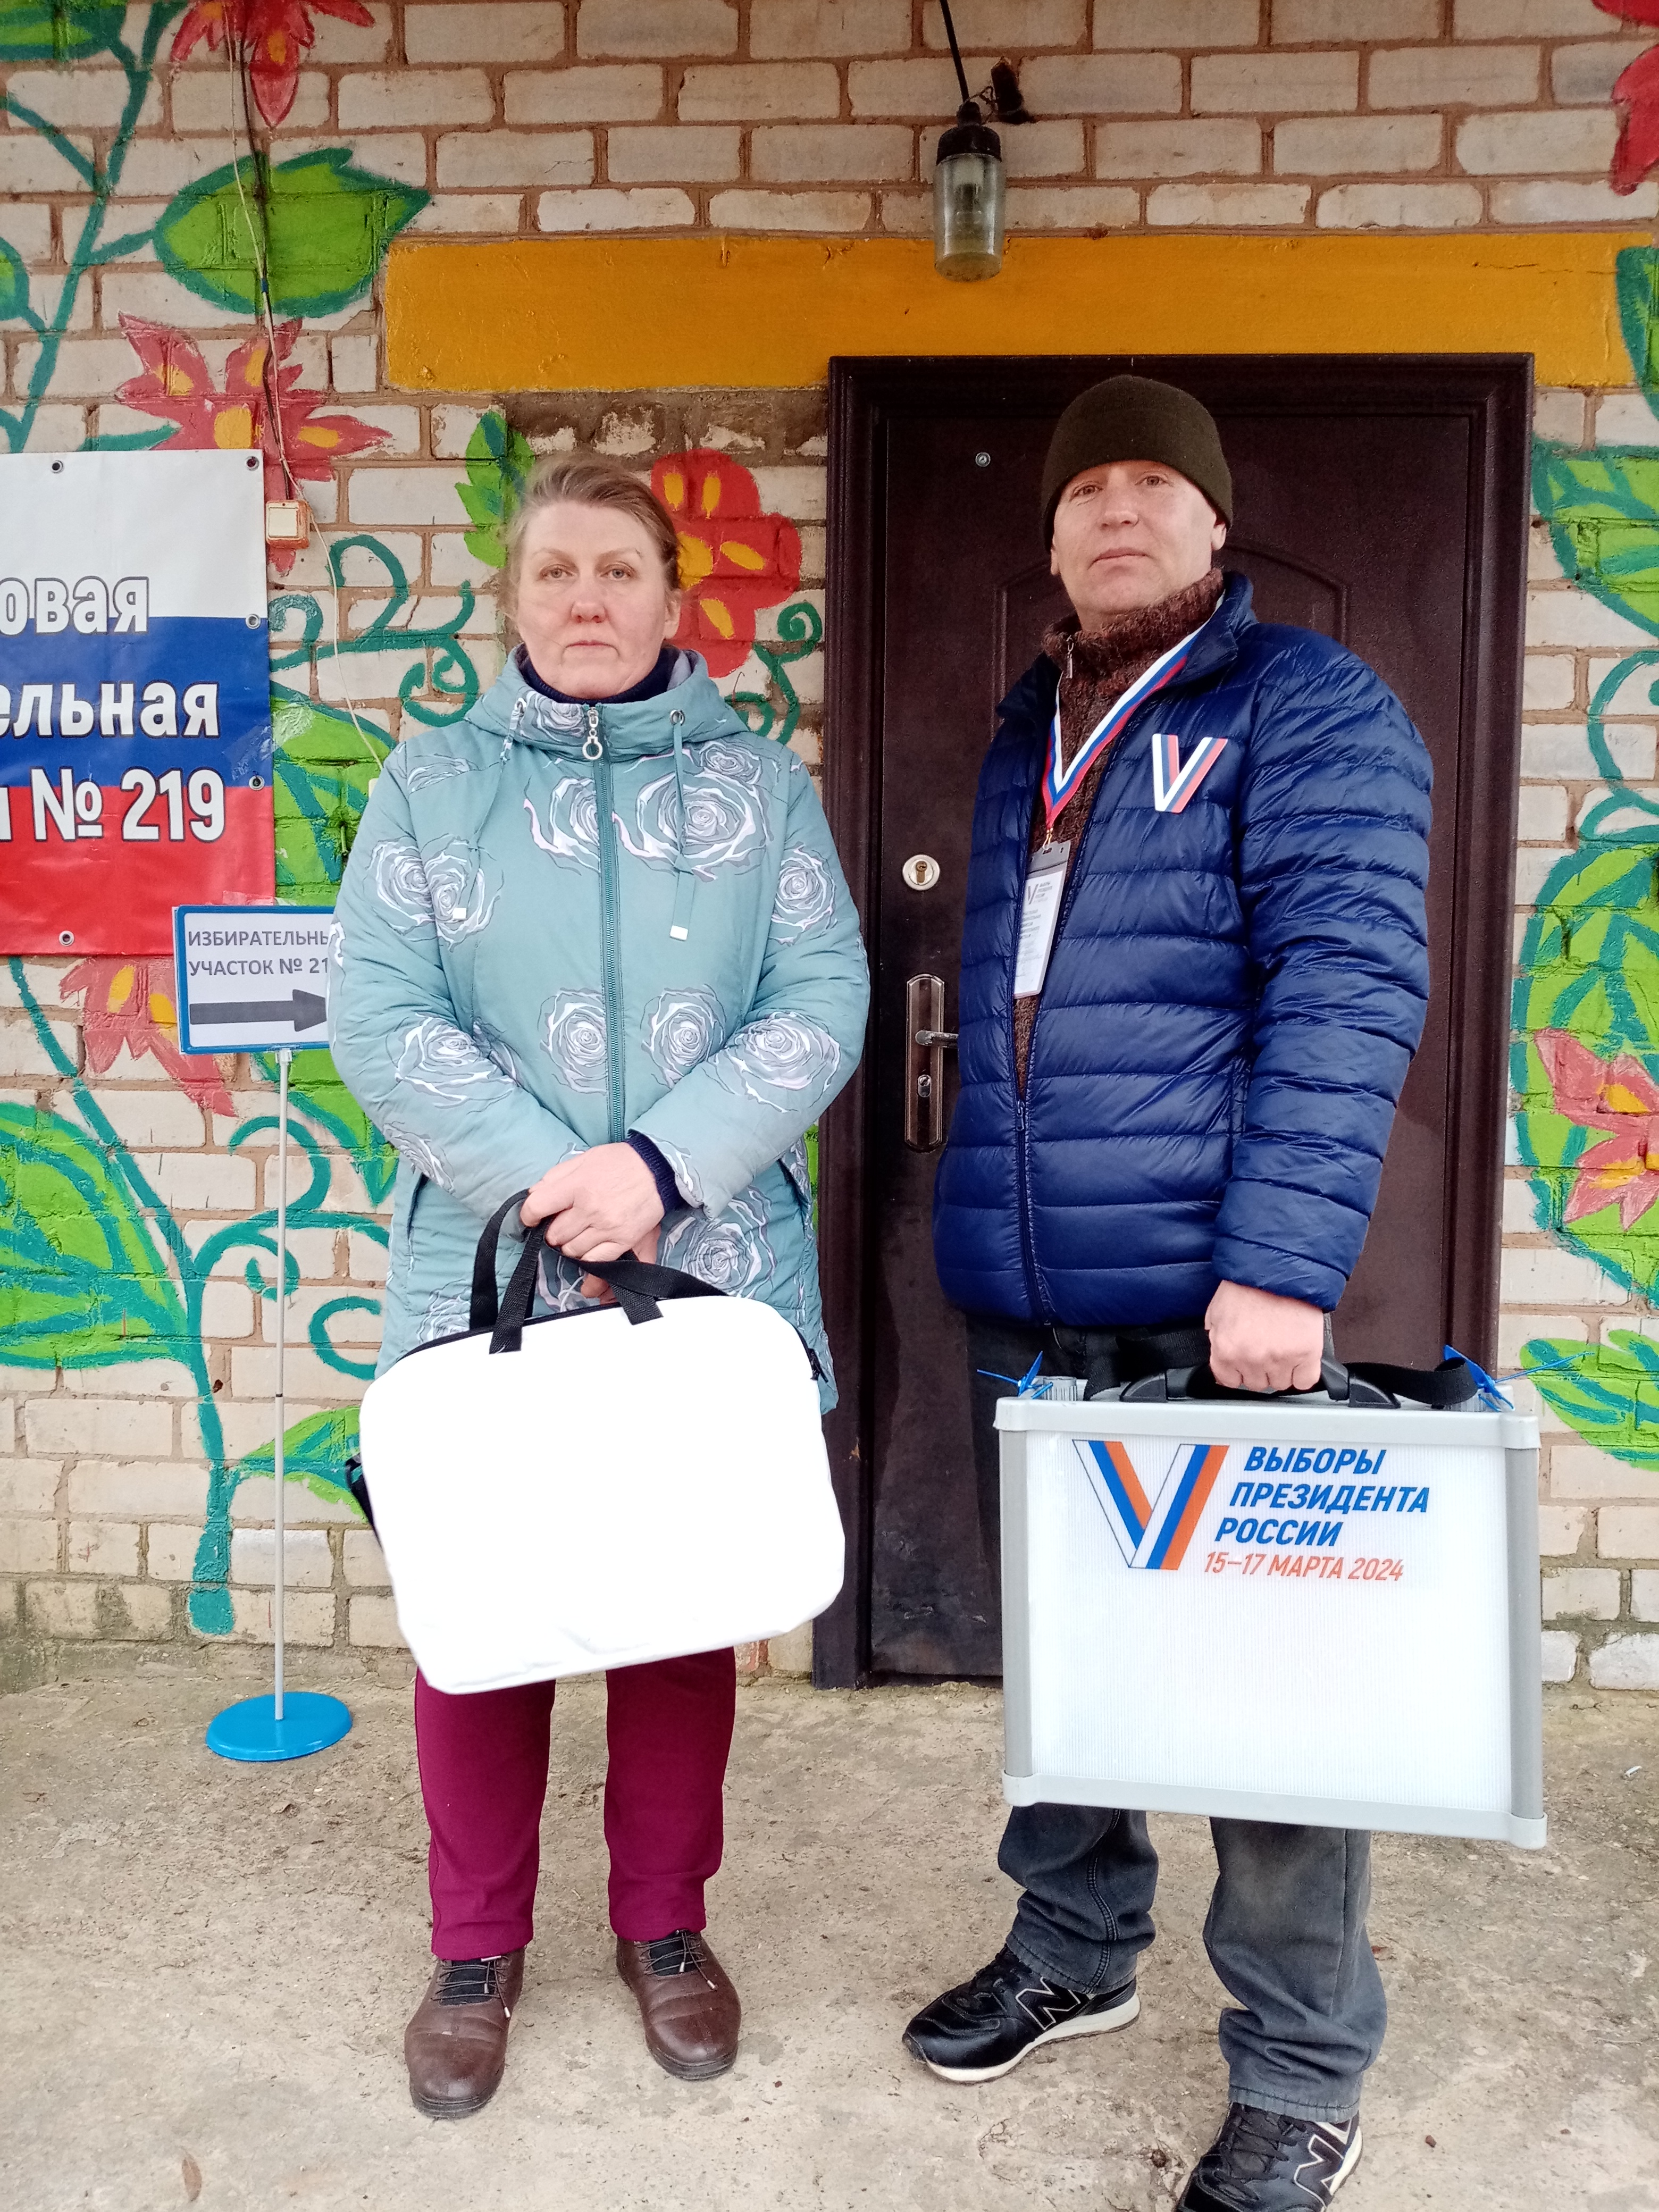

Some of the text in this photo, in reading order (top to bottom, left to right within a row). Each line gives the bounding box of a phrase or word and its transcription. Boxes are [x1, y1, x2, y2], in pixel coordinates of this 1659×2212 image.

[1152, 733, 1228, 813] V
[30, 766, 103, 842] №
[120, 766, 225, 843] 219
[189, 959, 273, 976] УЧАСТОК
[280, 958, 303, 974] №
[1244, 1446, 1386, 1474] ВЫБОРЫ
[1229, 1482, 1429, 1514] ПРЕЗИДЕНТА
[1214, 1517, 1343, 1546] РОССИИ
[1267, 1554, 1344, 1579] МАРТА
[1348, 1559, 1404, 1581] 2024
